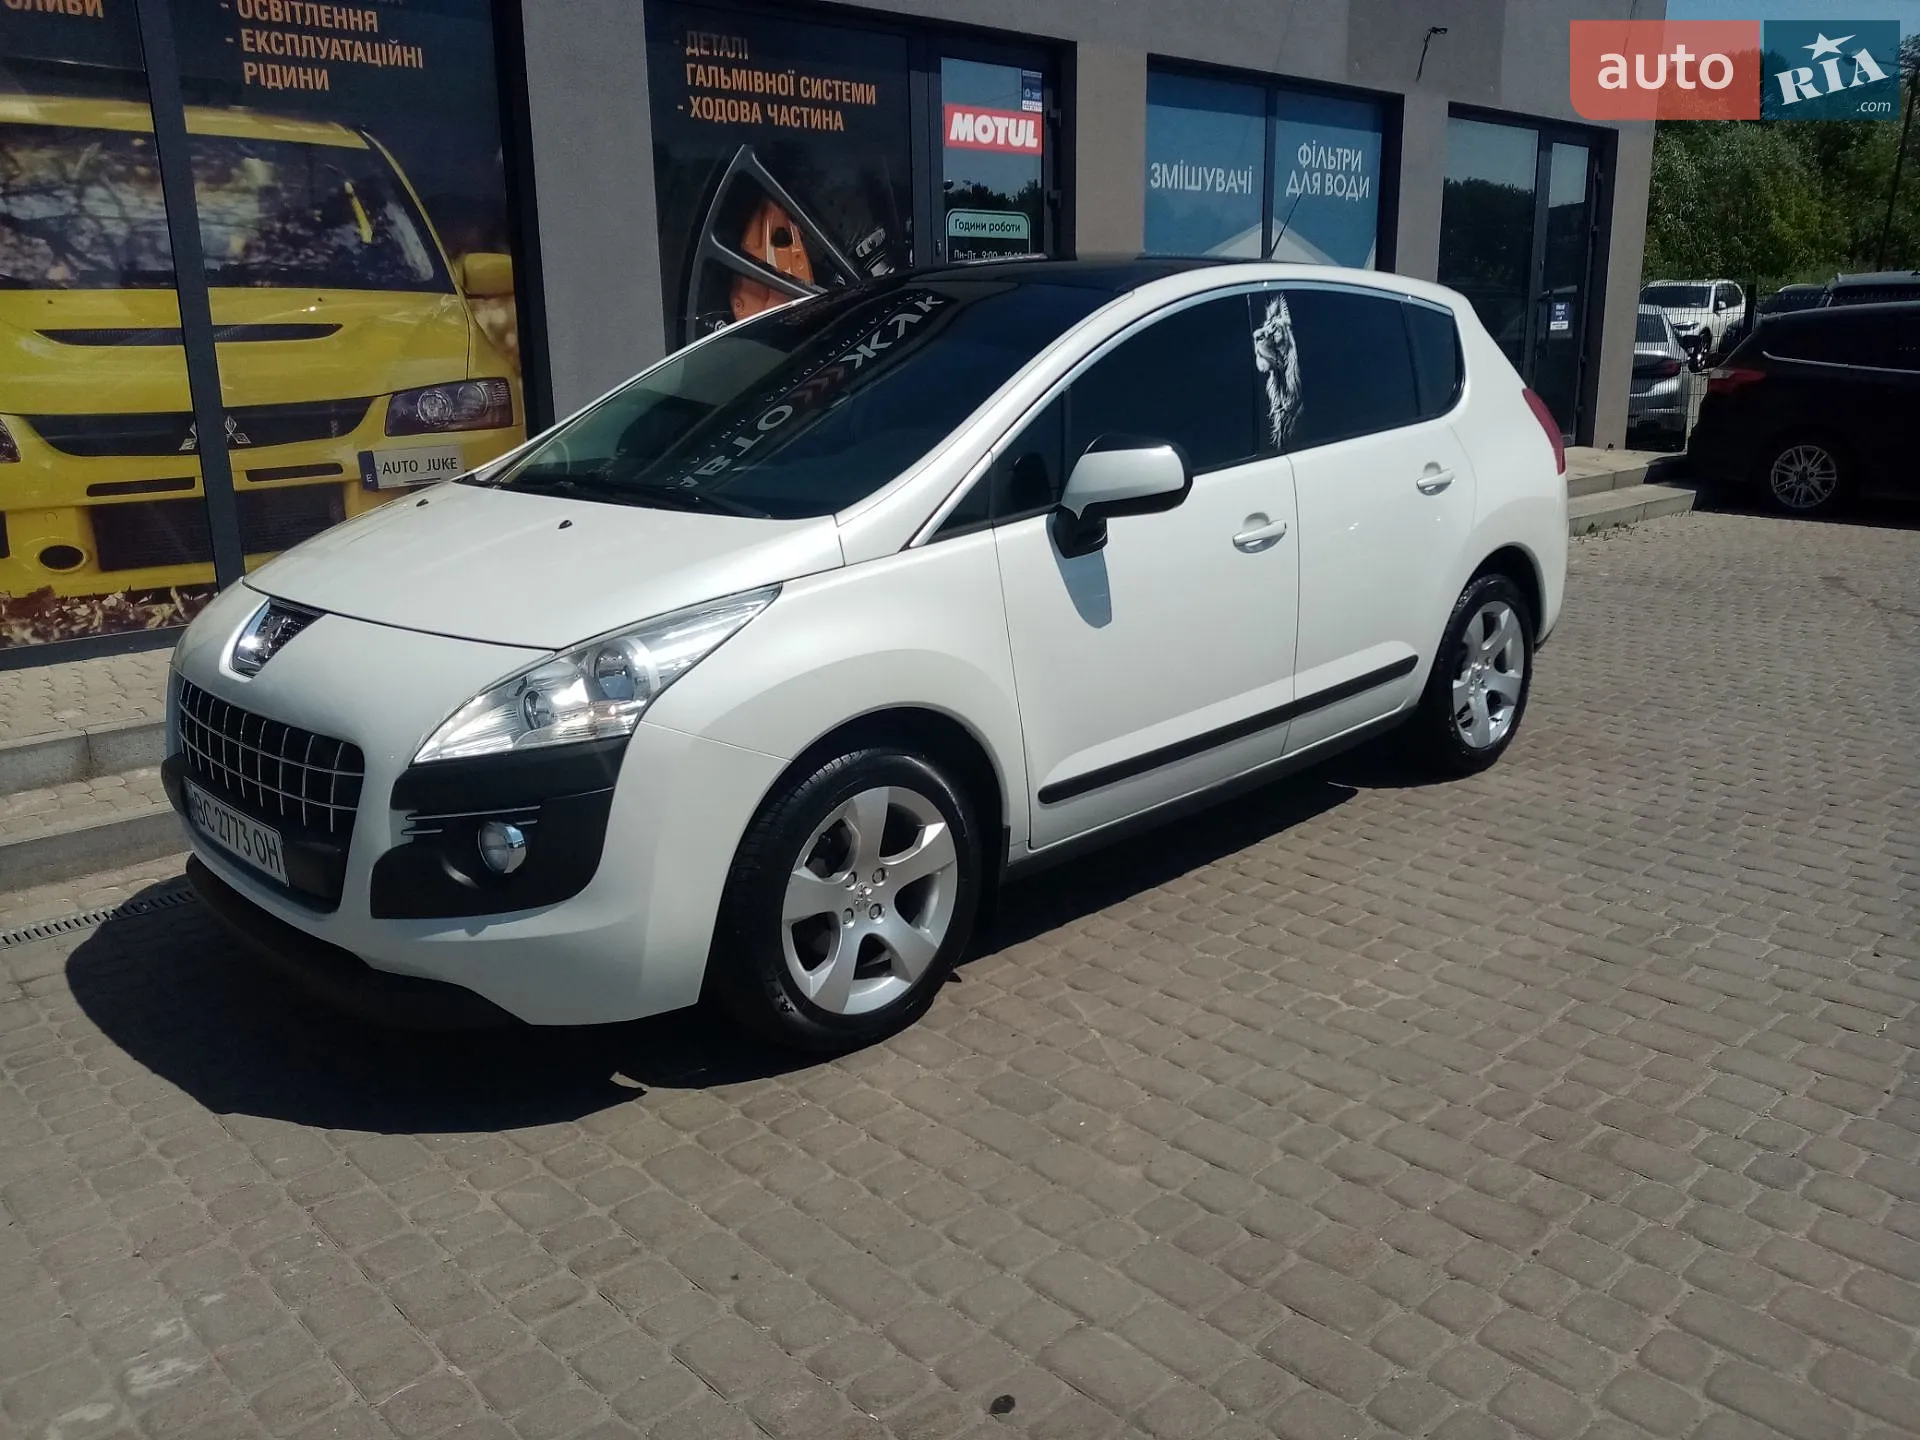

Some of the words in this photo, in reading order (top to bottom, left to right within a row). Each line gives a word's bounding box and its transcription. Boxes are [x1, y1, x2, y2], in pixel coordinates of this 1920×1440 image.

[237, 0, 379, 33] ОСВІТЛЕННЯ
[241, 28, 424, 69] ЕКСПЛУАТАЦІЙНІ
[686, 31, 748, 60] ДЕТАЛІ
[243, 62, 330, 91] РІДИНИ
[686, 64, 795, 97] ГАЛЬМІВНОЇ
[799, 76, 876, 105] СИСТЕМИ
[689, 95, 763, 125] ХОДОВА
[766, 103, 845, 132] ЧАСТИНА
[949, 111, 1038, 148] MOTUL
[1286, 169, 1321, 197] ДЛЯ
[1324, 173, 1370, 202] ВОДИ
[954, 218, 987, 232] Години
[988, 220, 1021, 233] роботи
[382, 459, 419, 476] AUTO
[426, 457, 458, 472] JUKE
[214, 806, 252, 857] 2773
[252, 828, 281, 874] OH
